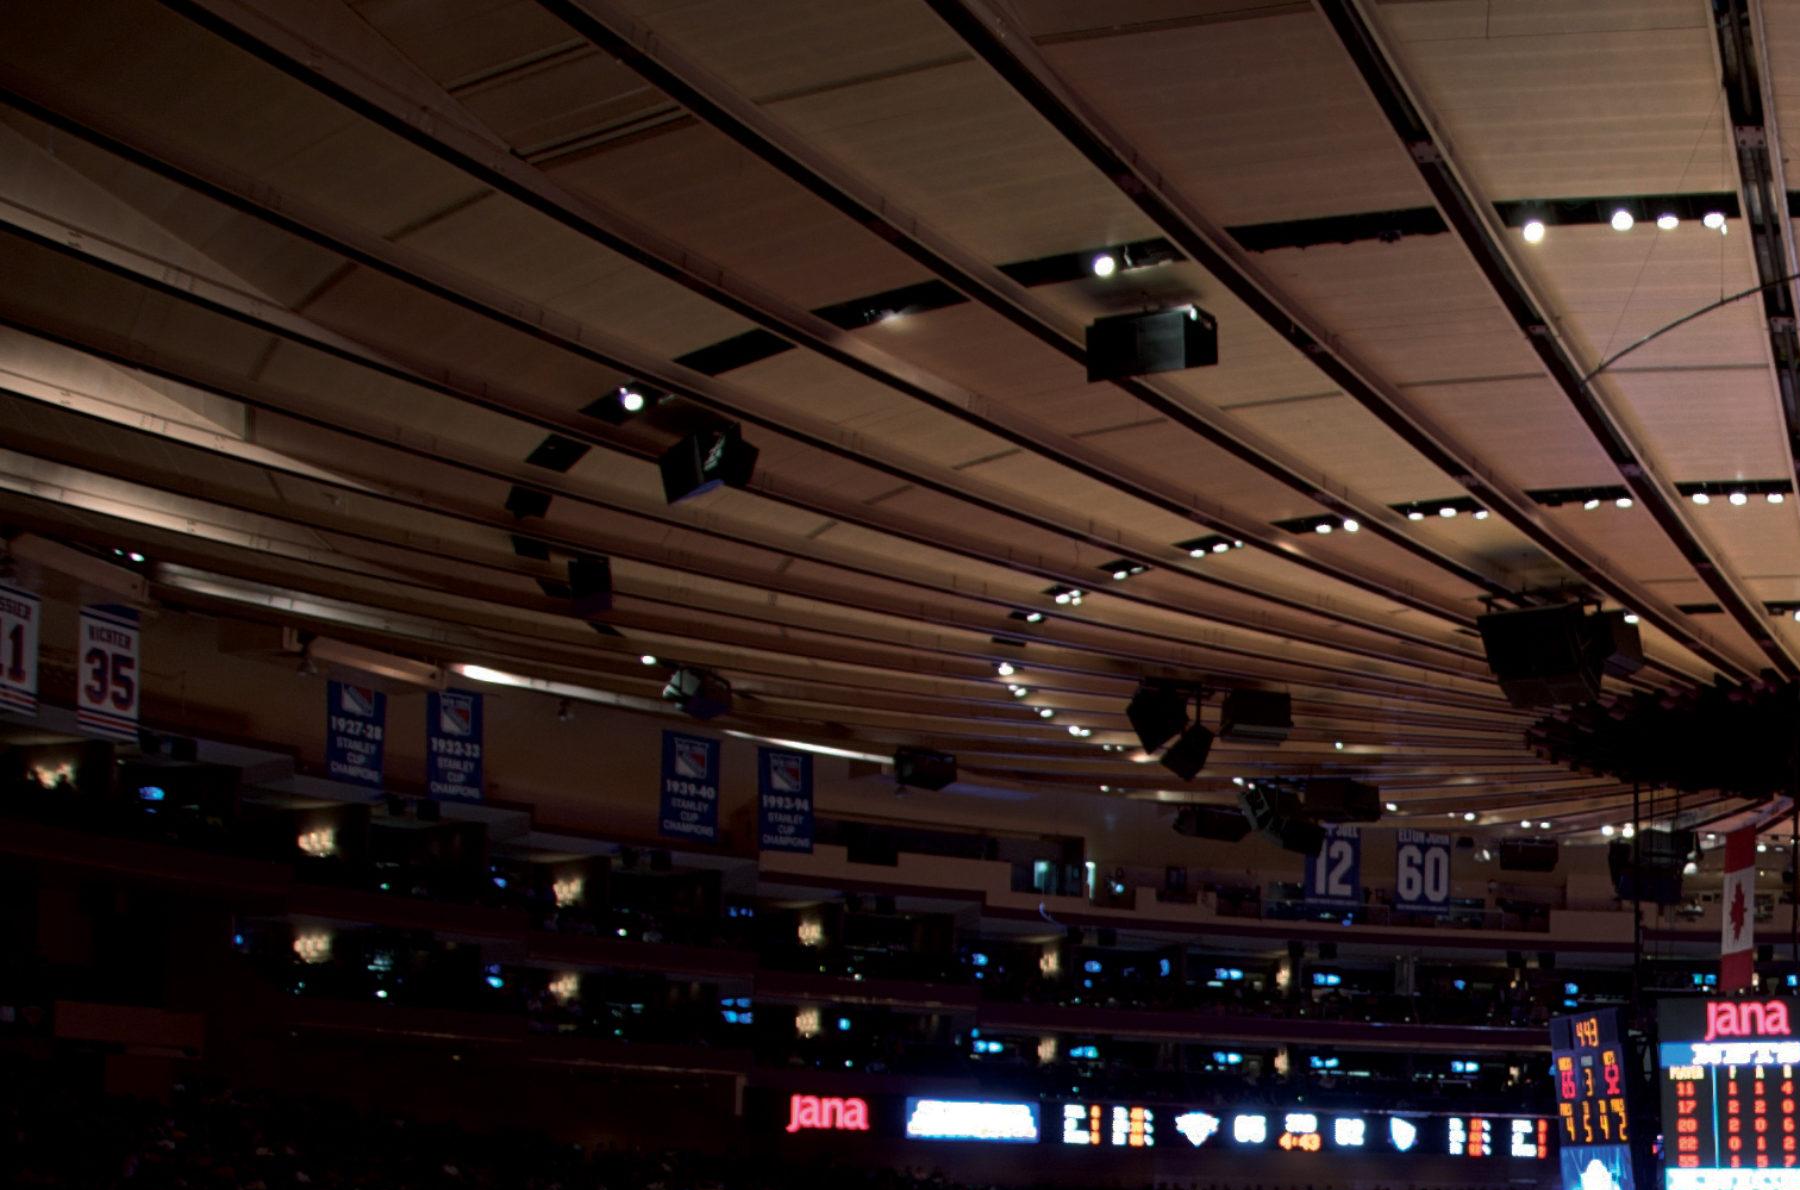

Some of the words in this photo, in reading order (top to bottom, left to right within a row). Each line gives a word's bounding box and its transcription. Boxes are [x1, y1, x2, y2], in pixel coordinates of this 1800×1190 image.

[89, 625, 131, 651] RICHTER
[0, 624, 26, 683] 1
[85, 647, 135, 712] 35
[331, 714, 383, 741] 1927-28
[336, 736, 377, 755] STANLEY
[346, 752, 368, 764] CUP
[437, 755, 475, 773] STANLEY
[330, 761, 380, 784] CHAMPIONS
[446, 770, 468, 783] CUP
[430, 782, 480, 799] CHAMPIONS
[666, 779, 716, 801] 1939-40
[671, 797, 709, 813] STANLEY
[680, 810, 699, 823] CUP
[768, 811, 804, 825] STANLEY
[663, 819, 714, 838] CHAMPIONS
[777, 824, 795, 835] CUP
[762, 833, 810, 848] CHAMPIONS
[1314, 838, 1354, 897] 12
[1397, 844, 1449, 903] 60
[1705, 1000, 1792, 1041] jana
[1677, 1081, 1695, 1097] 11
[1729, 1081, 1738, 1095] 1
[1755, 1081, 1764, 1095] 1
[1781, 1081, 1793, 1095] 4
[787, 1096, 868, 1132] jana
[1678, 1099, 1697, 1114] 17
[1728, 1099, 1740, 1114] 2
[1755, 1099, 1767, 1114] 2
[1728, 1117, 1740, 1133] 2
[1756, 1135, 1766, 1151] 1
[1783, 1135, 1795, 1151] 2
[1784, 1154, 1796, 1168] 7
